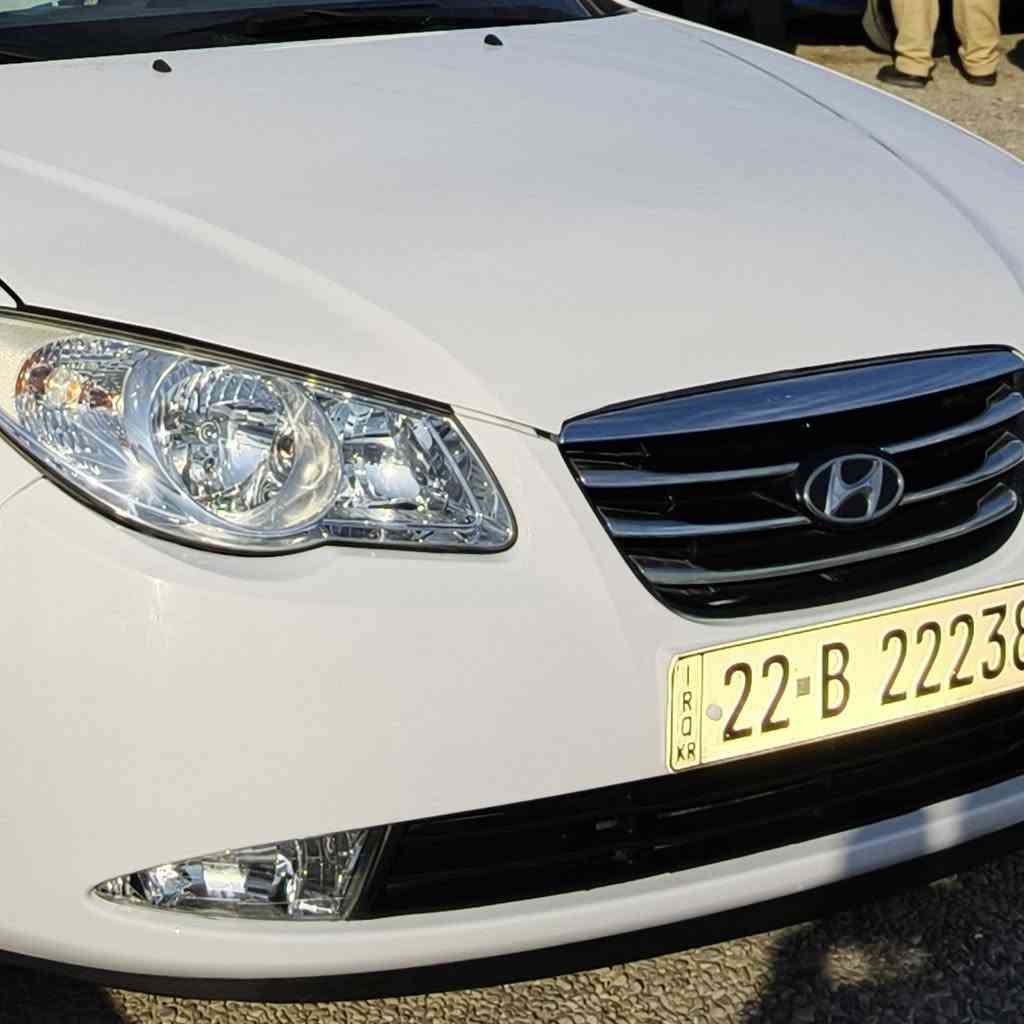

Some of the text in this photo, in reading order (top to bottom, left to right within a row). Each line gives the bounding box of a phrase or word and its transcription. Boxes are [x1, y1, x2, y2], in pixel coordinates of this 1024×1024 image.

[723, 654, 791, 743] 22
[821, 641, 851, 720] B
[676, 741, 697, 762] KR
